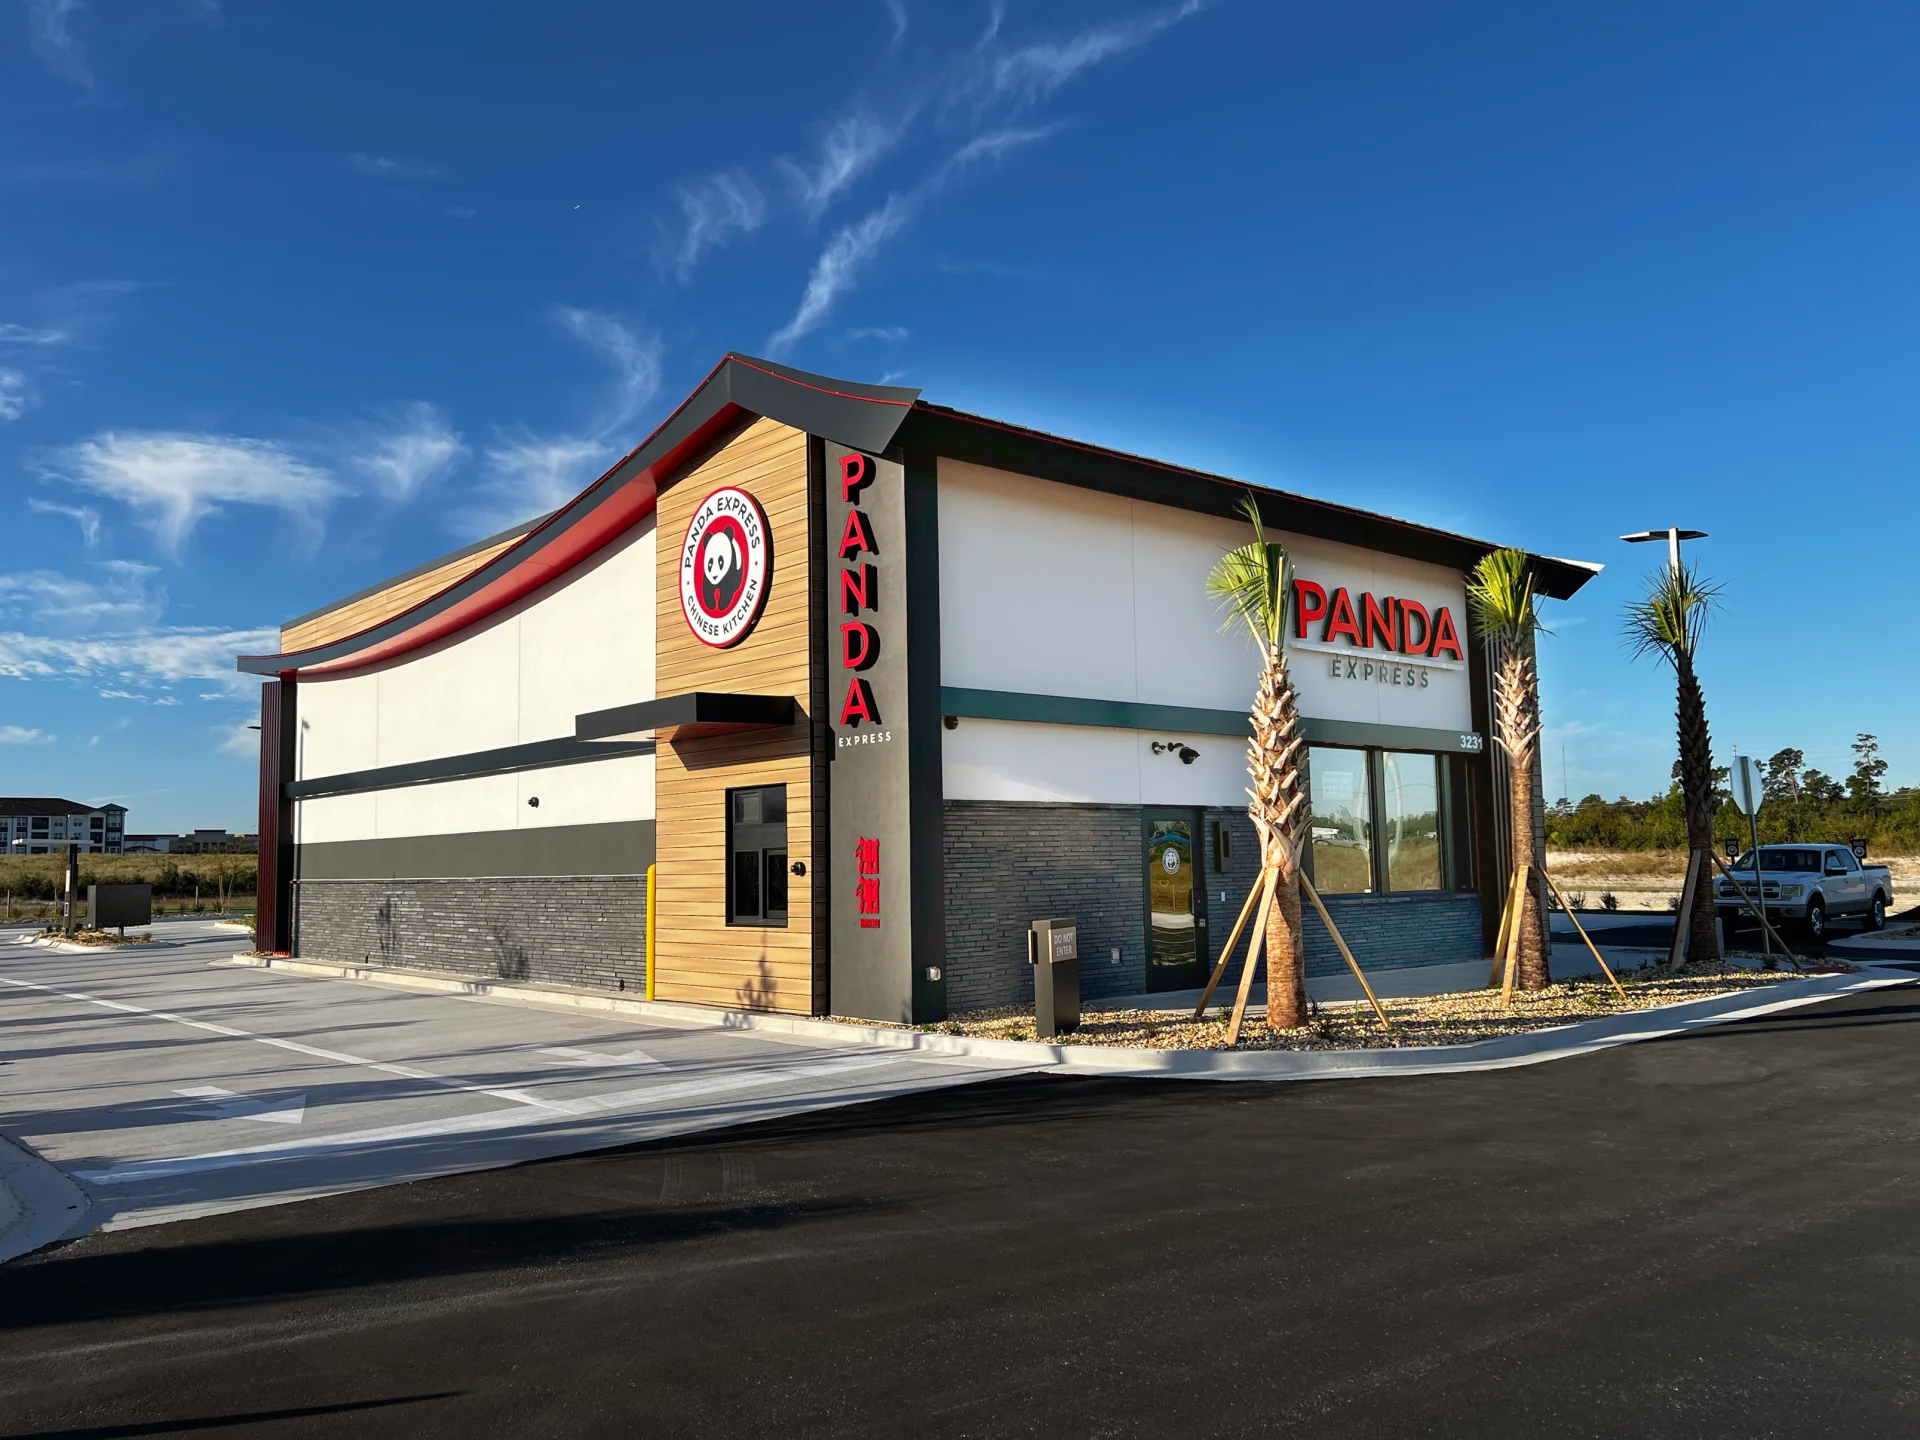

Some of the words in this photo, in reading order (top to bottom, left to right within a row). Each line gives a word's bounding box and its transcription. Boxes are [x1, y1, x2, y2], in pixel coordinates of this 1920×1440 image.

[684, 506, 714, 568] PANDA
[717, 496, 761, 549] EXPRESS
[839, 453, 876, 726] PANDA
[687, 595, 719, 637] CHINESE
[723, 579, 758, 635] KITCHEN
[1293, 578, 1464, 661] PANDA
[1332, 659, 1429, 688] EXPRESS
[838, 731, 892, 747] EXPRESS
[1460, 735, 1483, 750] 3231
[1054, 934, 1062, 944] DO
[1062, 932, 1073, 943] NOT
[1056, 945, 1072, 957] ENTER
